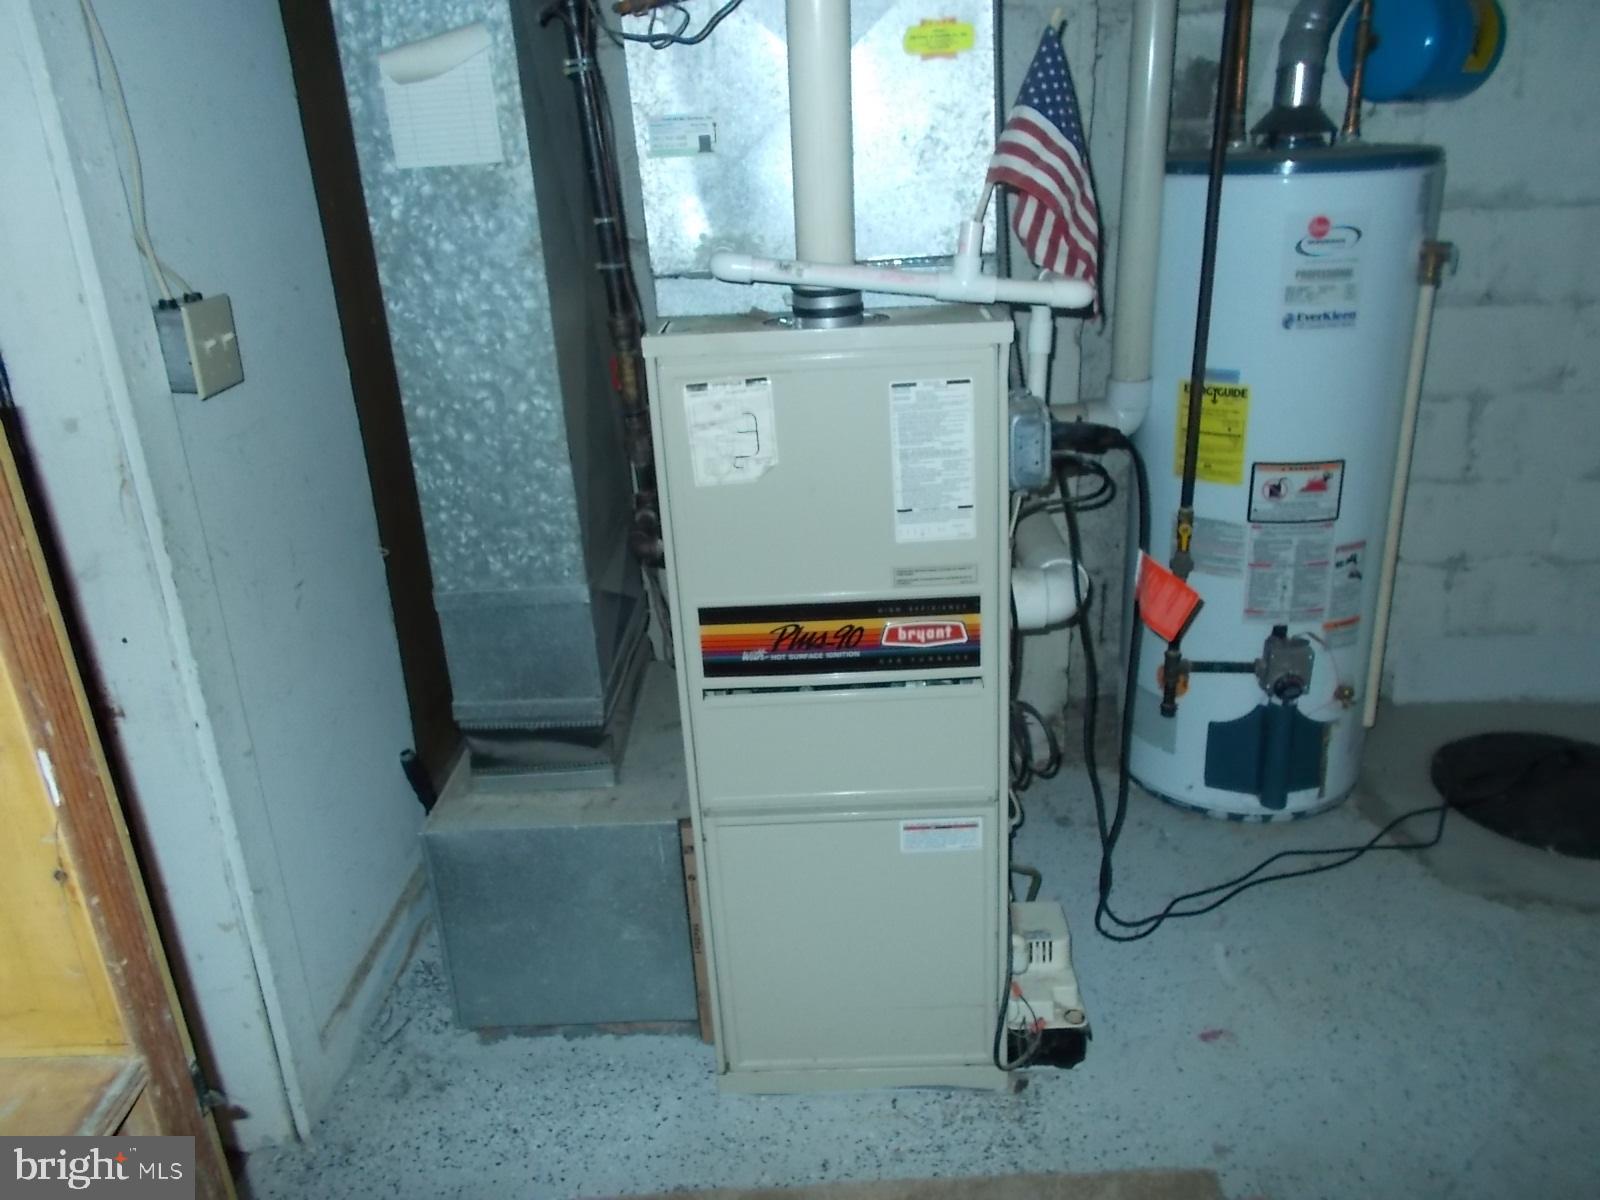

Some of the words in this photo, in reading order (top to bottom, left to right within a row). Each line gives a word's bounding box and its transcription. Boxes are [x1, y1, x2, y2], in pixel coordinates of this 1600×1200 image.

[897, 625, 954, 643] bryant
[788, 652, 823, 660] SURFACE
[825, 651, 860, 659] IGNITION
